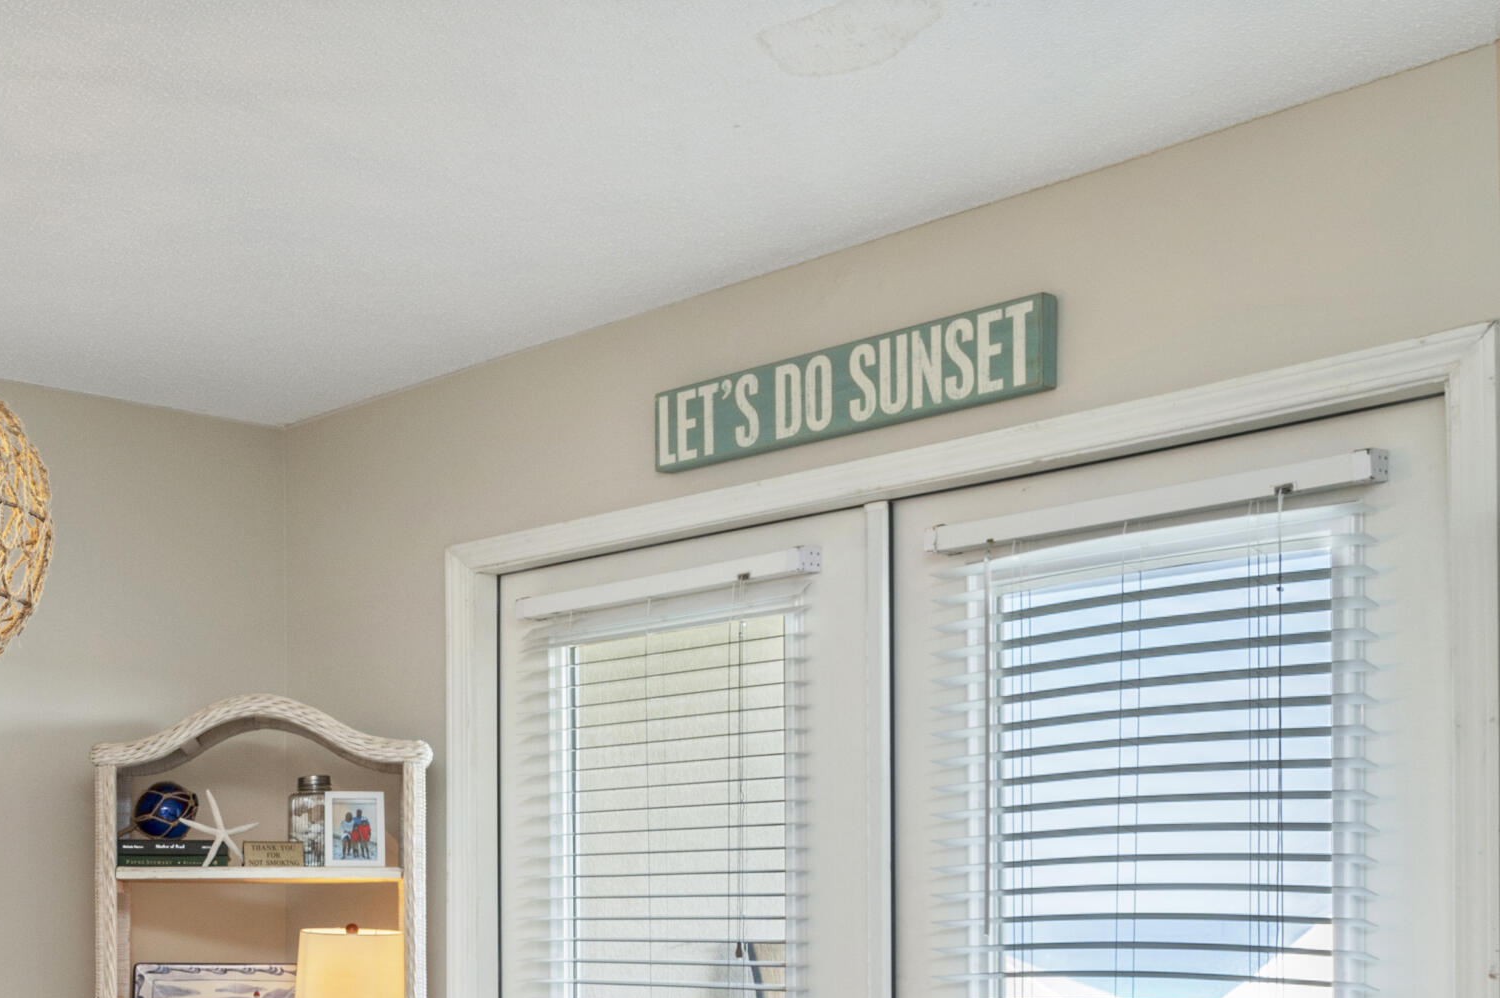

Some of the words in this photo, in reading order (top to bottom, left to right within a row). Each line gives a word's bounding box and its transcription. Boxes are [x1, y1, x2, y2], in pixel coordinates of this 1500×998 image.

[659, 374, 760, 466] LET’S
[775, 355, 833, 440] DO
[849, 300, 1035, 423] SUNSET
